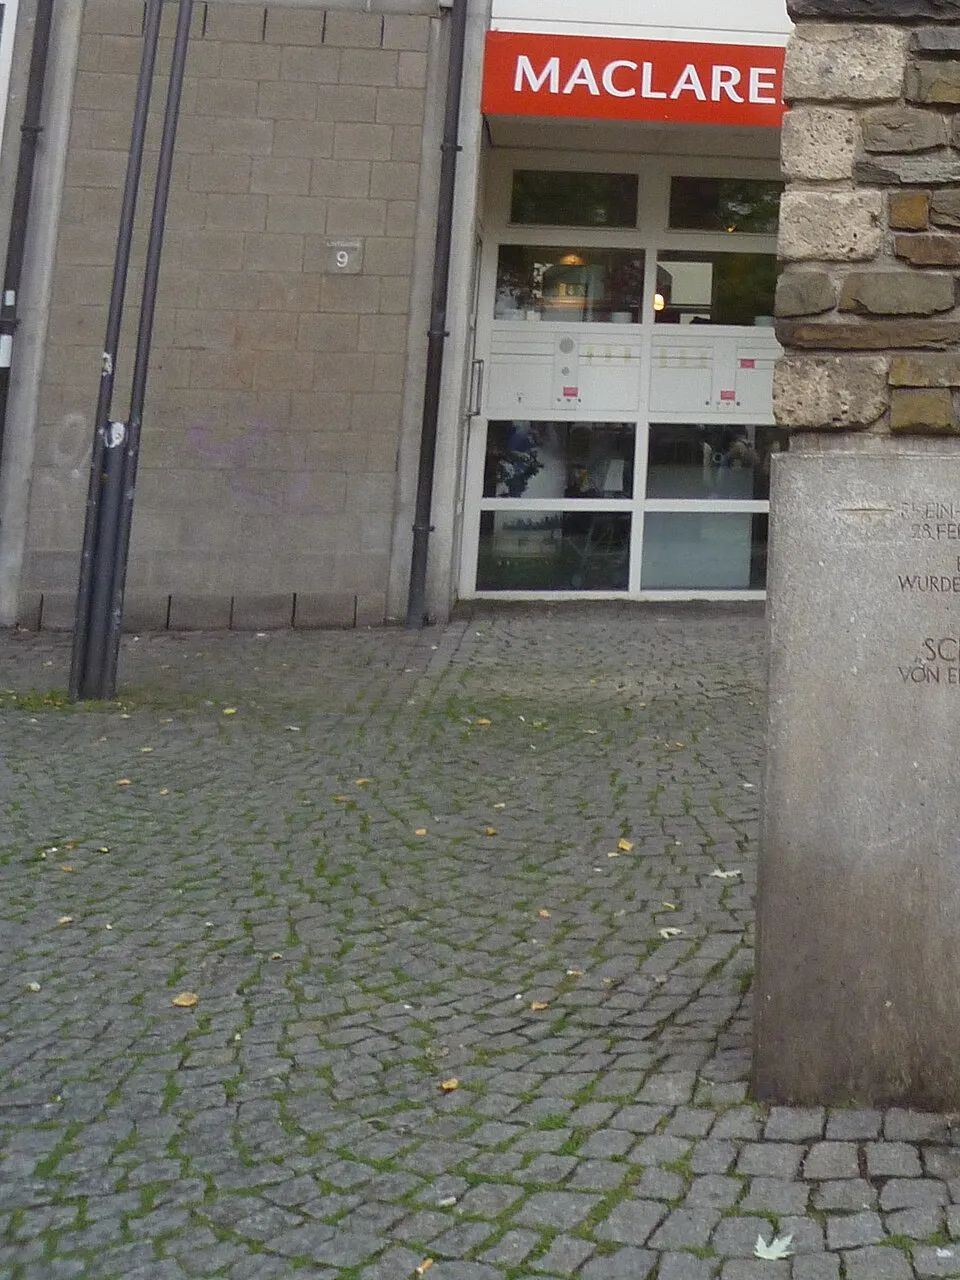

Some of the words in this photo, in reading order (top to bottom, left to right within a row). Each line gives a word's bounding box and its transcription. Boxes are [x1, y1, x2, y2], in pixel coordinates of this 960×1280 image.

[513, 55, 785, 105] MACLARE
[336, 251, 348, 267] 9
[898, 575, 960, 593] WURDE
[898, 666, 939, 685] VON
